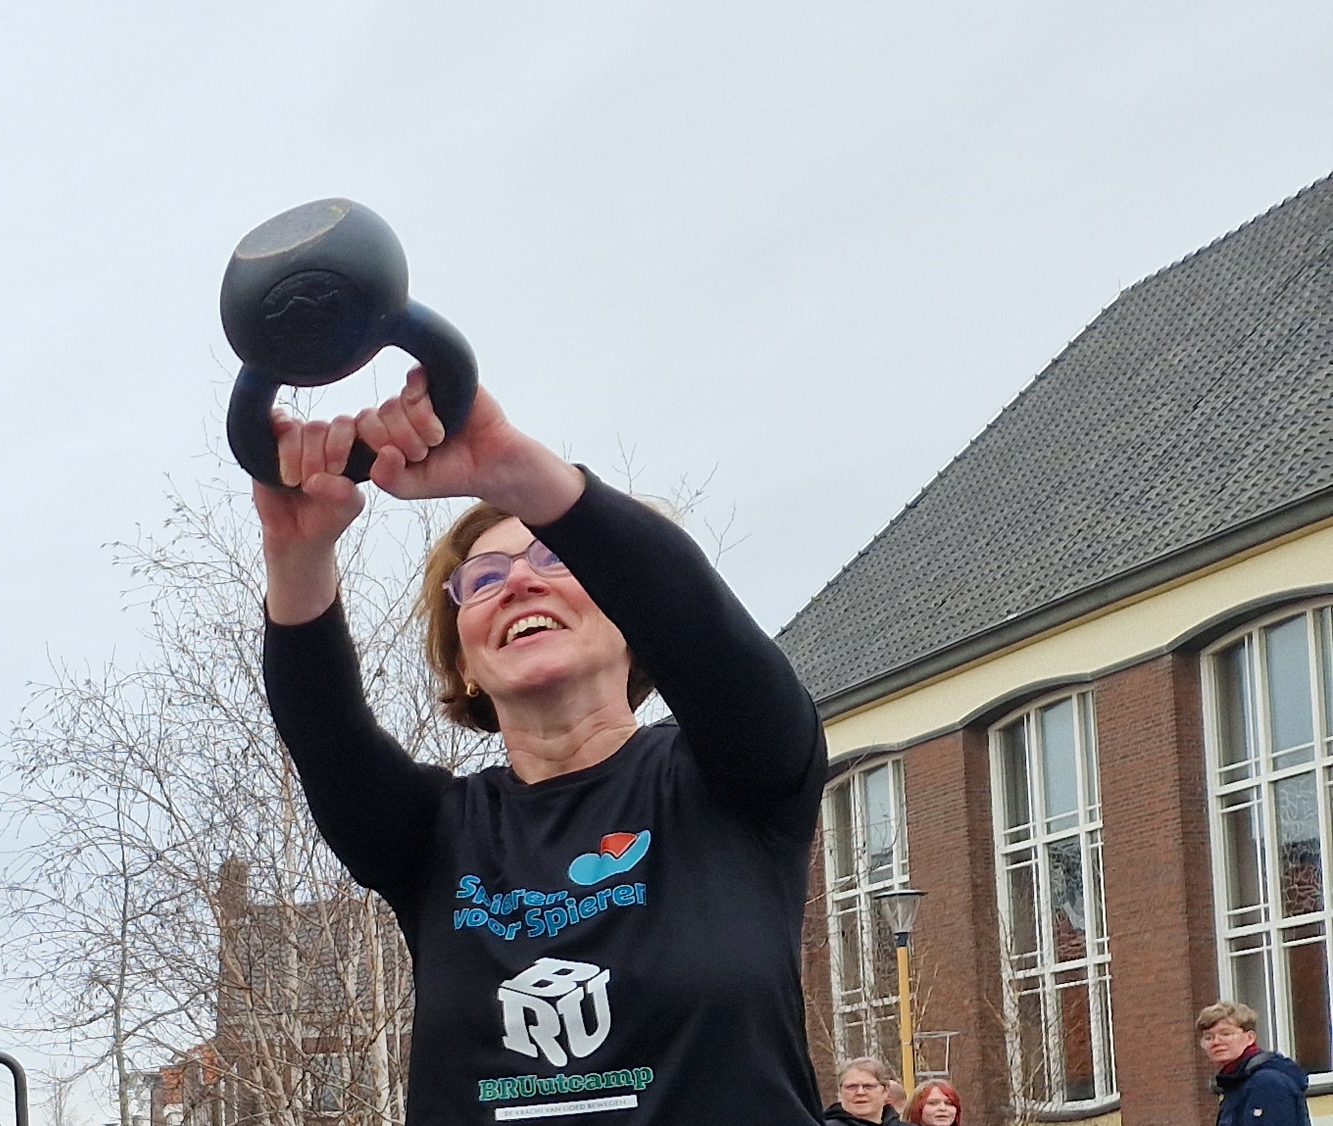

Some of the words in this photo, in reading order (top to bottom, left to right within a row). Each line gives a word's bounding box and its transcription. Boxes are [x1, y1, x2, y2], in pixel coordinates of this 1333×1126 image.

[453, 908, 522, 940] voor
[497, 957, 611, 1068] BRU
[478, 1066, 653, 1103] BRUutcamp
